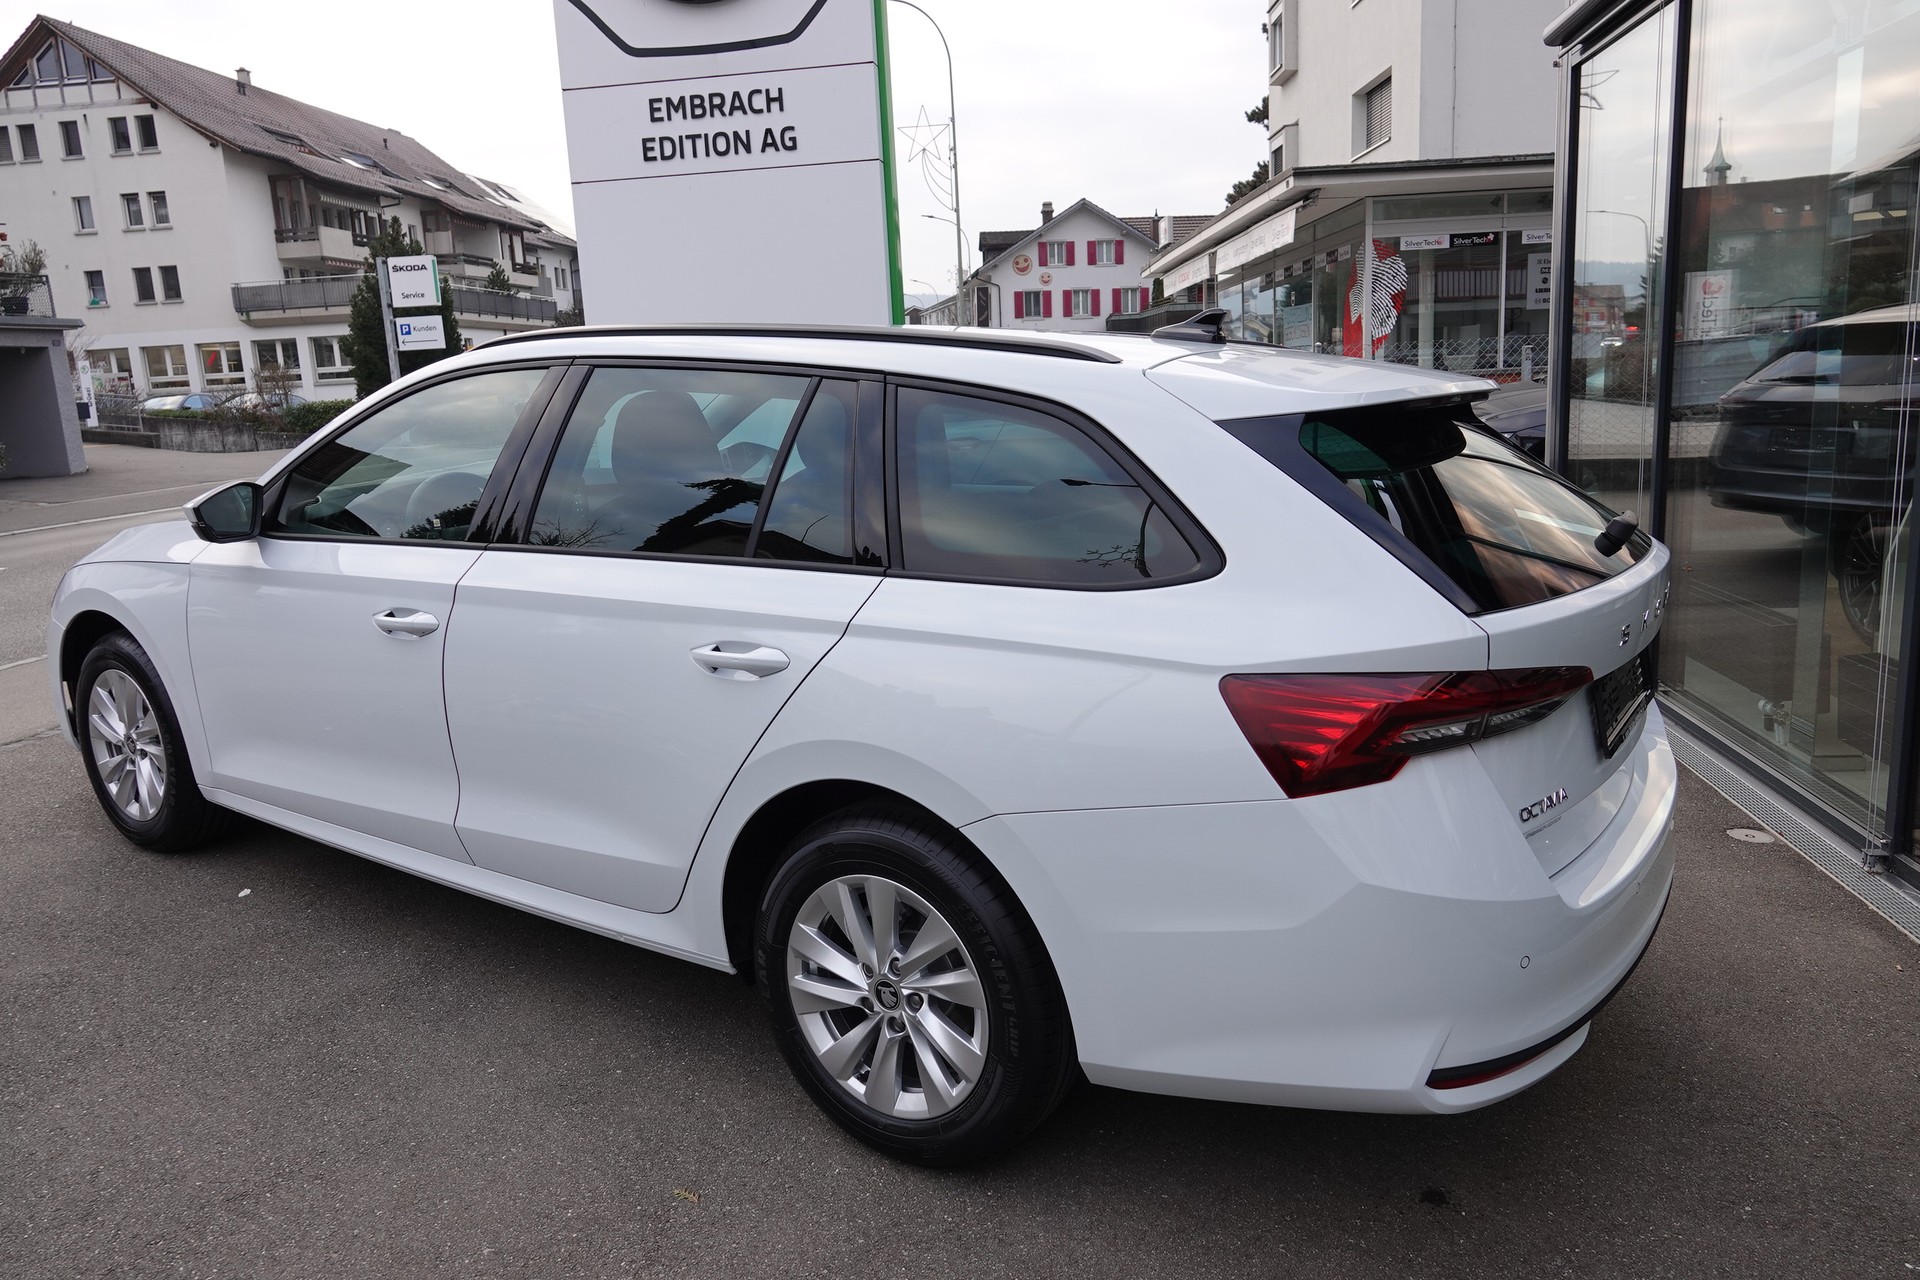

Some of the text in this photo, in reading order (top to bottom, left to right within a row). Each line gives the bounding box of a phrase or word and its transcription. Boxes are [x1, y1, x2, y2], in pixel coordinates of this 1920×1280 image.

[648, 87, 785, 123] EMBRACH
[641, 126, 798, 162] EDITION AG
[392, 264, 428, 273] ŠKODA
[401, 291, 425, 300] Service
[1518, 787, 1569, 823] OCTAVIA
